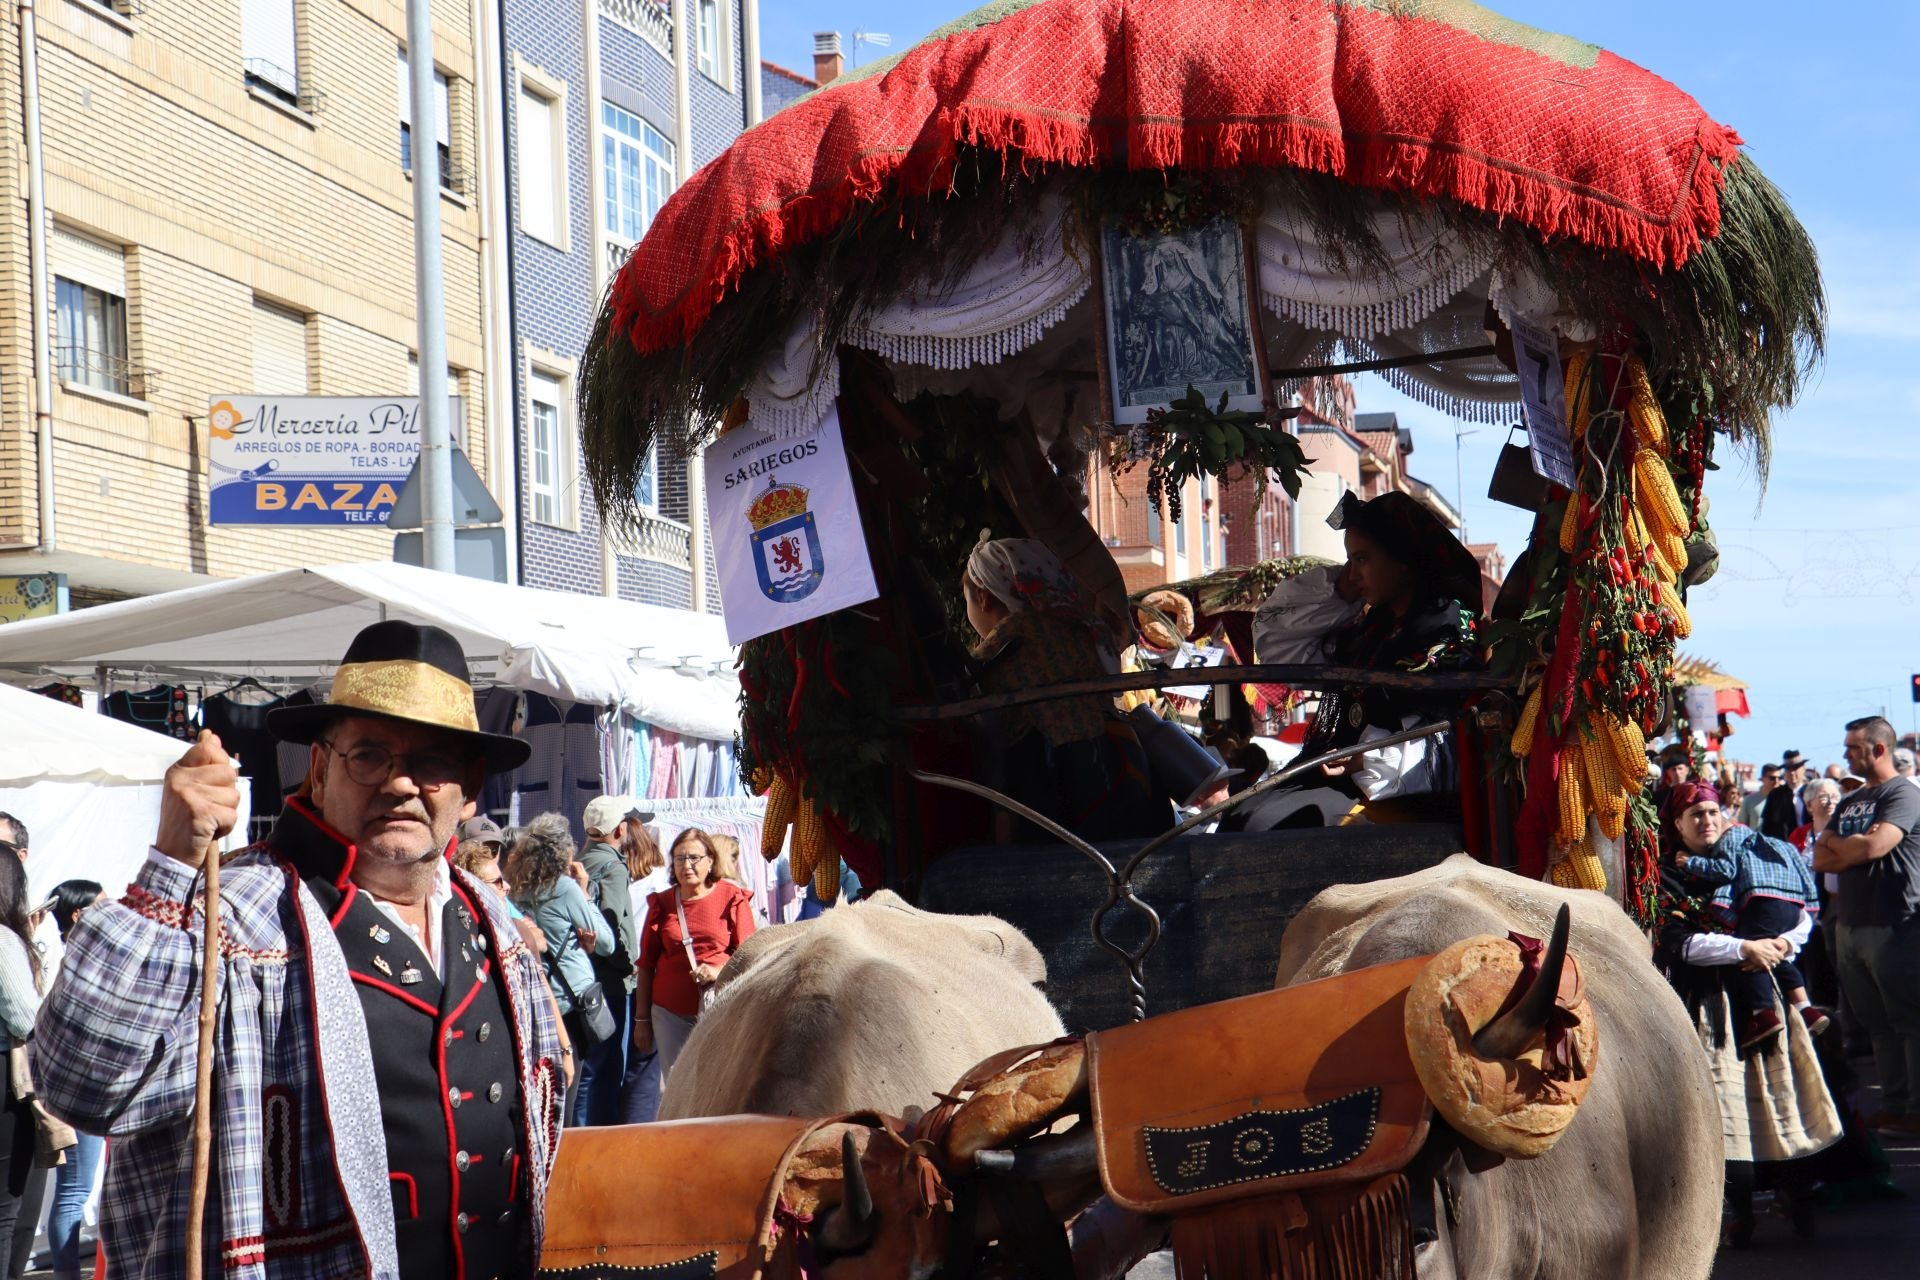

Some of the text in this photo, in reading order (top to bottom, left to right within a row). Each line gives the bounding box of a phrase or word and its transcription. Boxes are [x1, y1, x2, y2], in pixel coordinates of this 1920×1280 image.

[1524, 345, 1549, 405] 7
[368, 403, 420, 434] Pil
[234, 442, 302, 453] ARREGLOS
[305, 442, 321, 453] DE
[325, 442, 359, 453] ROPA
[370, 442, 420, 453] BORDAD
[350, 456, 389, 467] TELAS
[400, 456, 415, 467] LA
[724, 439, 818, 490] SARIEGOS
[256, 484, 398, 510] BAZA
[344, 511, 376, 521] TELF.
